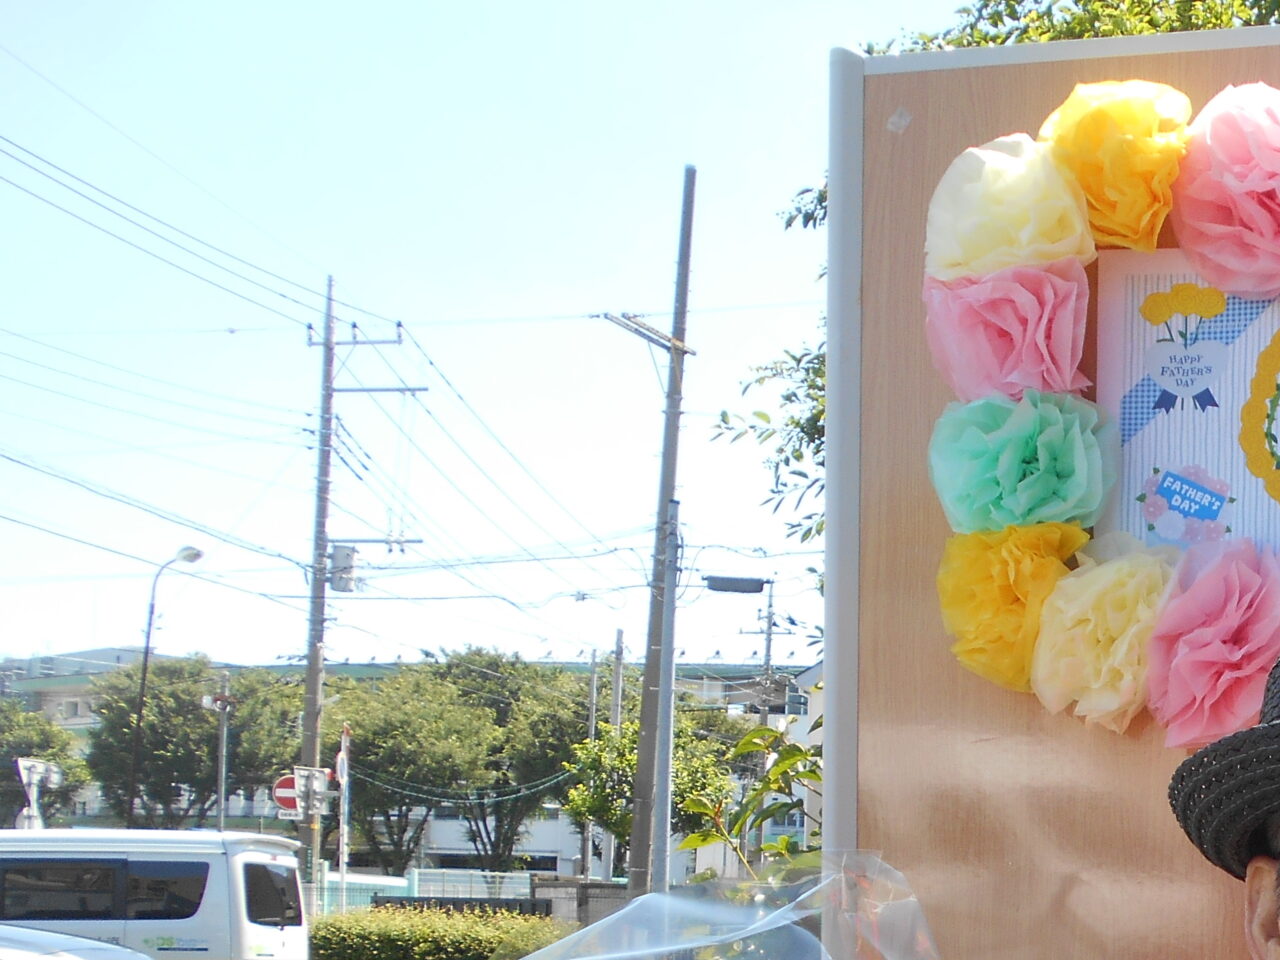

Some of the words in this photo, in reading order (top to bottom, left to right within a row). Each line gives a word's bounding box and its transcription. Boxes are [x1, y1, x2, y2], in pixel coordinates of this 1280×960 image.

[1168, 354, 1205, 366] HAPPY
[1160, 365, 1213, 378] FATHER'S
[1175, 378, 1198, 389] DAY
[1162, 476, 1222, 511] FATHER'S
[1171, 493, 1200, 514] DAY
